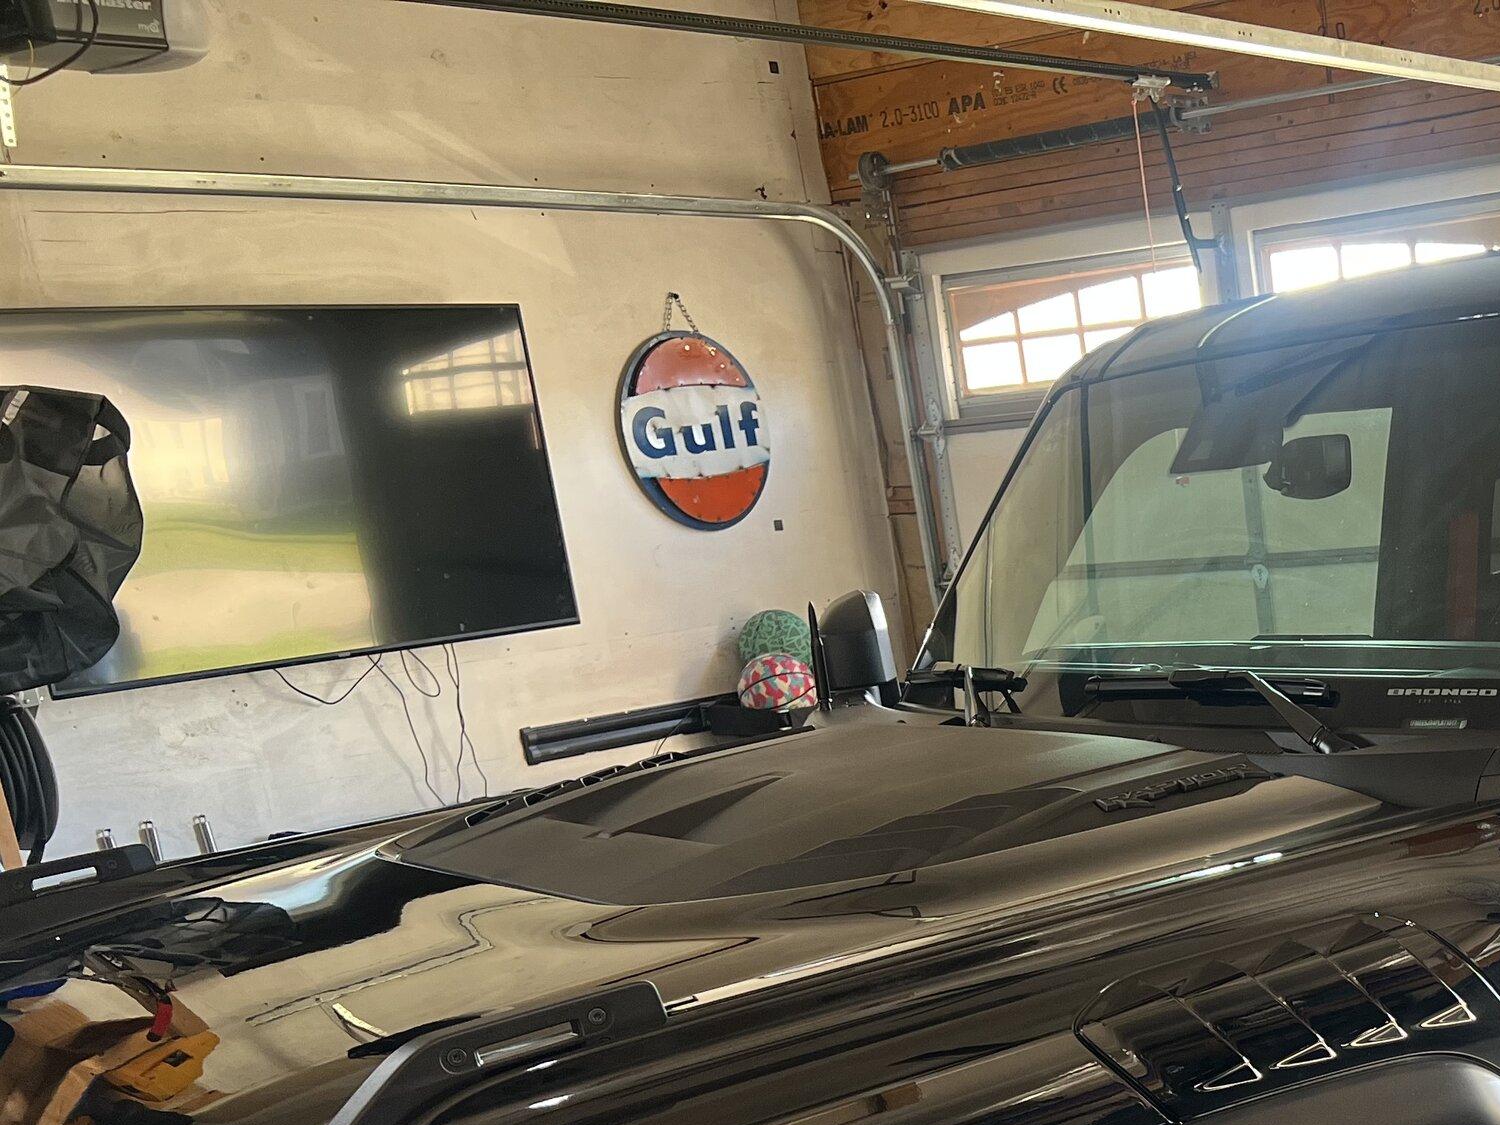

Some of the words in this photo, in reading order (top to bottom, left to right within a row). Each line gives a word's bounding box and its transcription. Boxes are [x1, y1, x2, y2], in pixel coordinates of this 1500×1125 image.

[879, 101, 940, 128] 2.0-3100
[948, 91, 986, 116] APA
[632, 401, 760, 459] Gulf
[1387, 688, 1498, 697] BRONCO
[1093, 763, 1272, 813] RAPTOR
